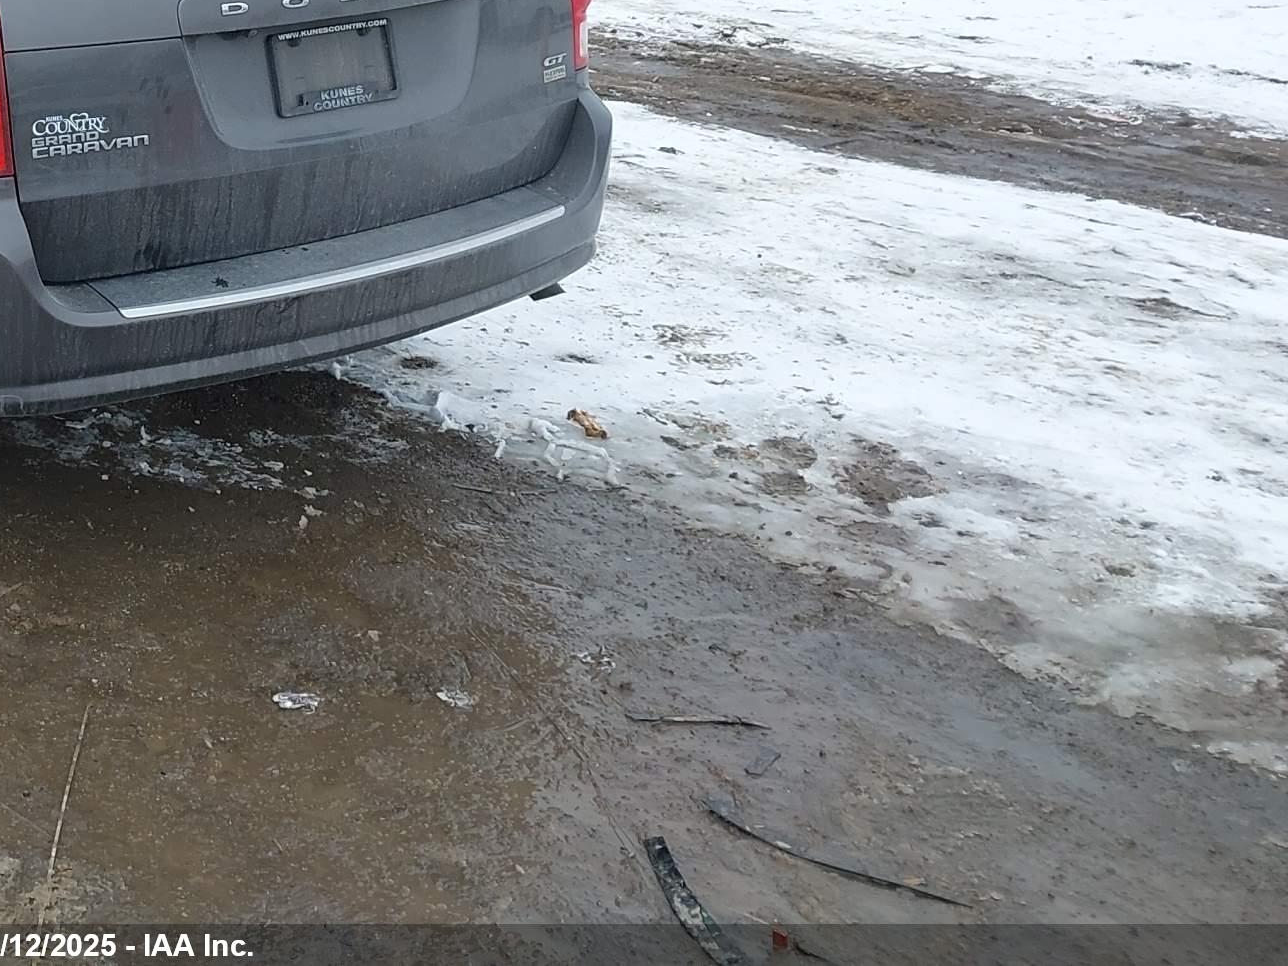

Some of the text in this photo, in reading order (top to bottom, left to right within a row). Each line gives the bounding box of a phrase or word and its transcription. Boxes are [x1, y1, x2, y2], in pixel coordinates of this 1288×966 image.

[278, 18, 388, 41] WWW.KUNESCOUNTRY.COM
[543, 52, 568, 67] GT
[321, 85, 364, 100] KUNES
[313, 92, 373, 112] COUNTRY
[32, 131, 99, 147] GRAND
[32, 134, 150, 159] CARAVAN
